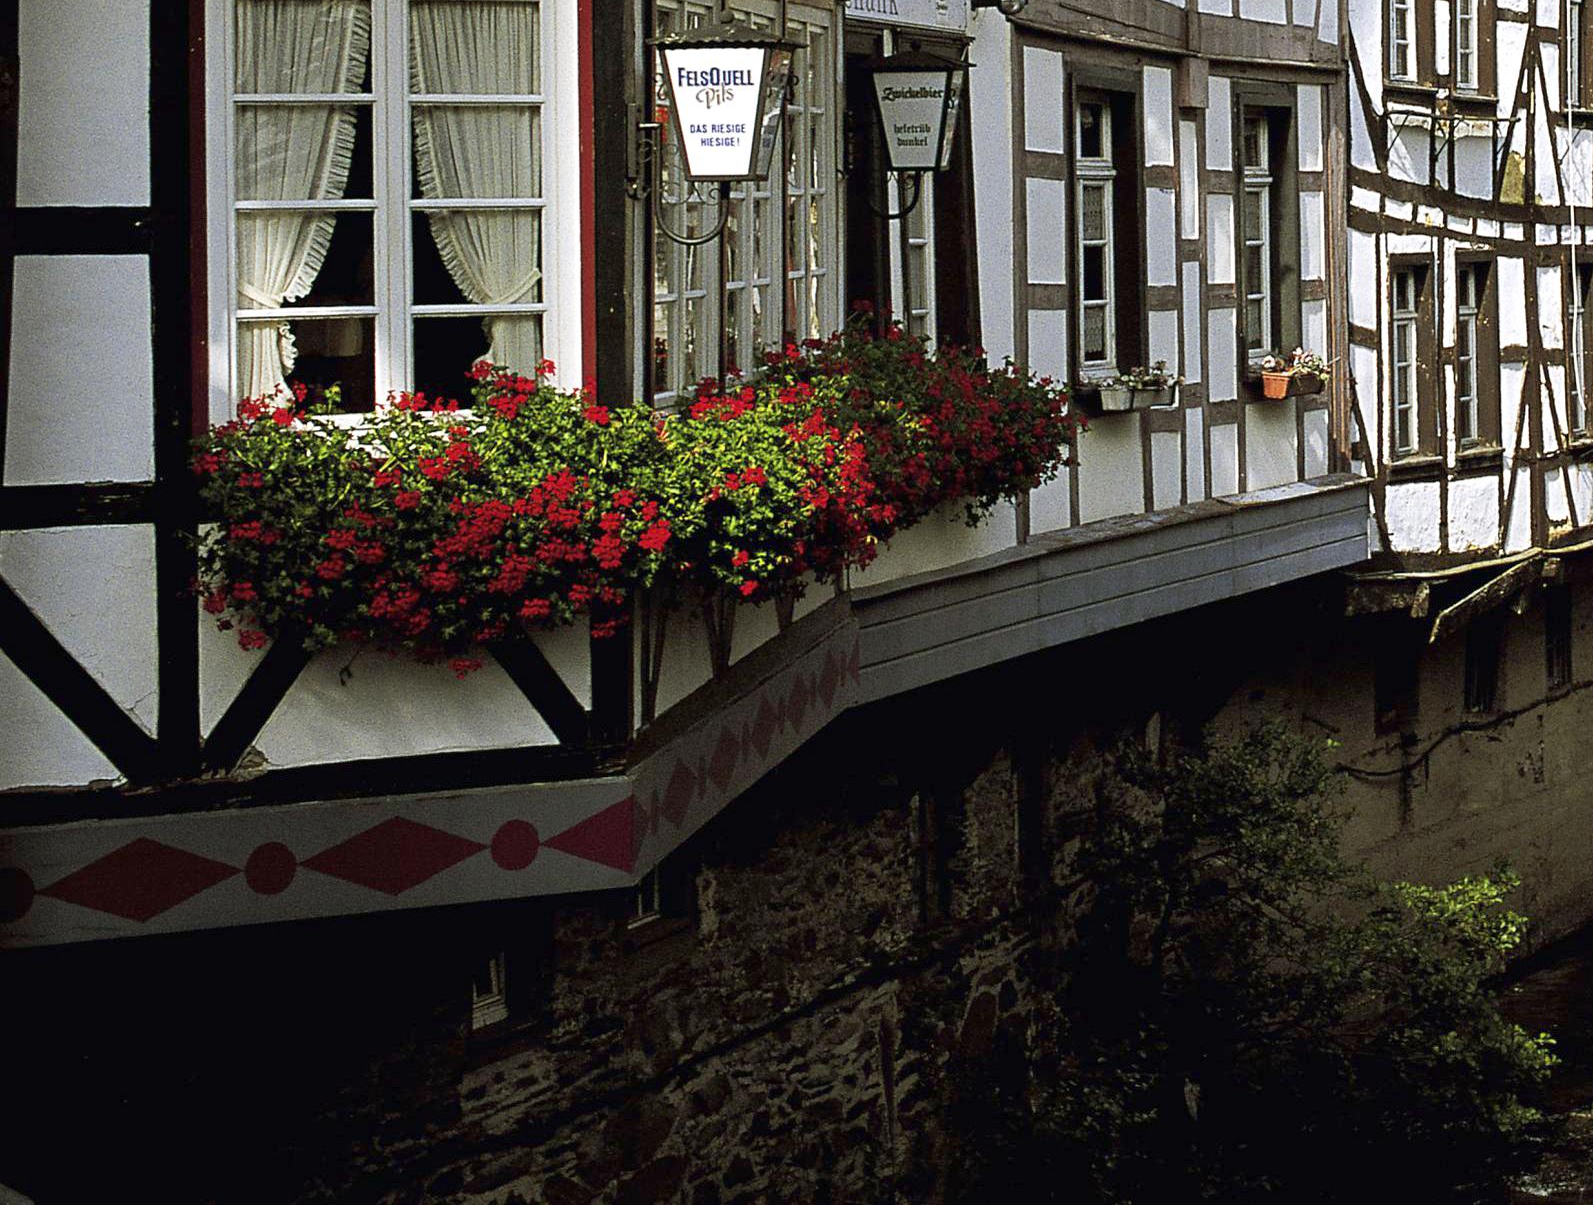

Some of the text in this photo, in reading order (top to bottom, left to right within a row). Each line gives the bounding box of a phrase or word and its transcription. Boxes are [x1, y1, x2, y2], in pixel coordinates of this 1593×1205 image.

[695, 82, 735, 110] Pils
[881, 86, 944, 102] Zwickelbier
[689, 123, 747, 134] DAS RIESIGE
[700, 137, 740, 147] HIESIGE!
[896, 136, 929, 147] dunkel
